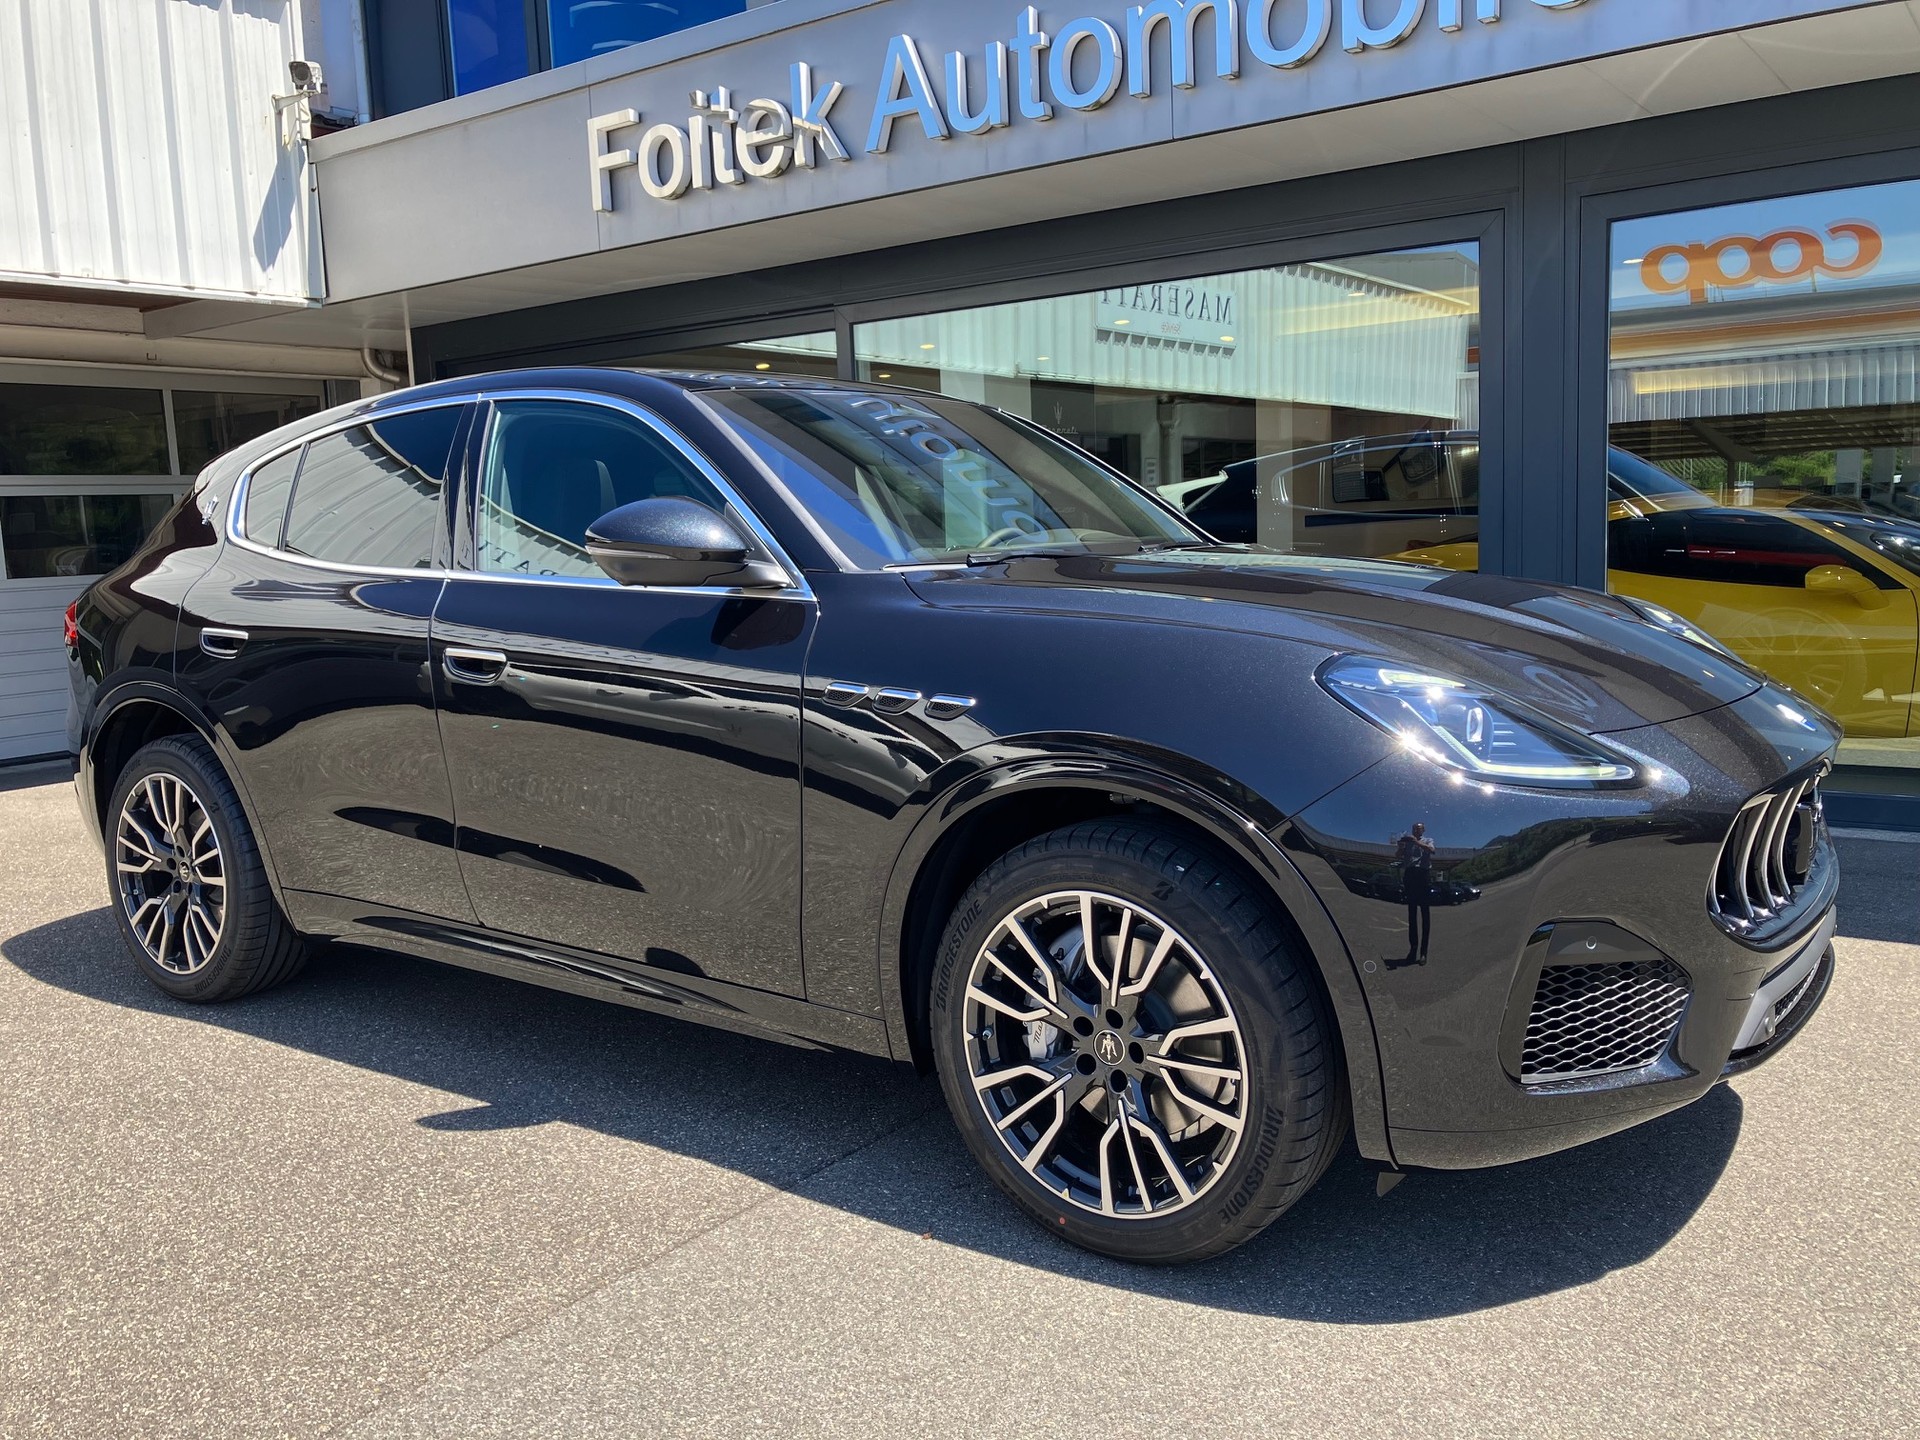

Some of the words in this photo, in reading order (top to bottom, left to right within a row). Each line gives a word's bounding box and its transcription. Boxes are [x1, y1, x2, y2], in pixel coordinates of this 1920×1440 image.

[587, 61, 850, 213] Foitek
[864, 0, 1590, 153] Automo
[936, 899, 982, 1012] BRIDGESTONE
[1218, 1104, 1284, 1225] BRIDGESTONE
